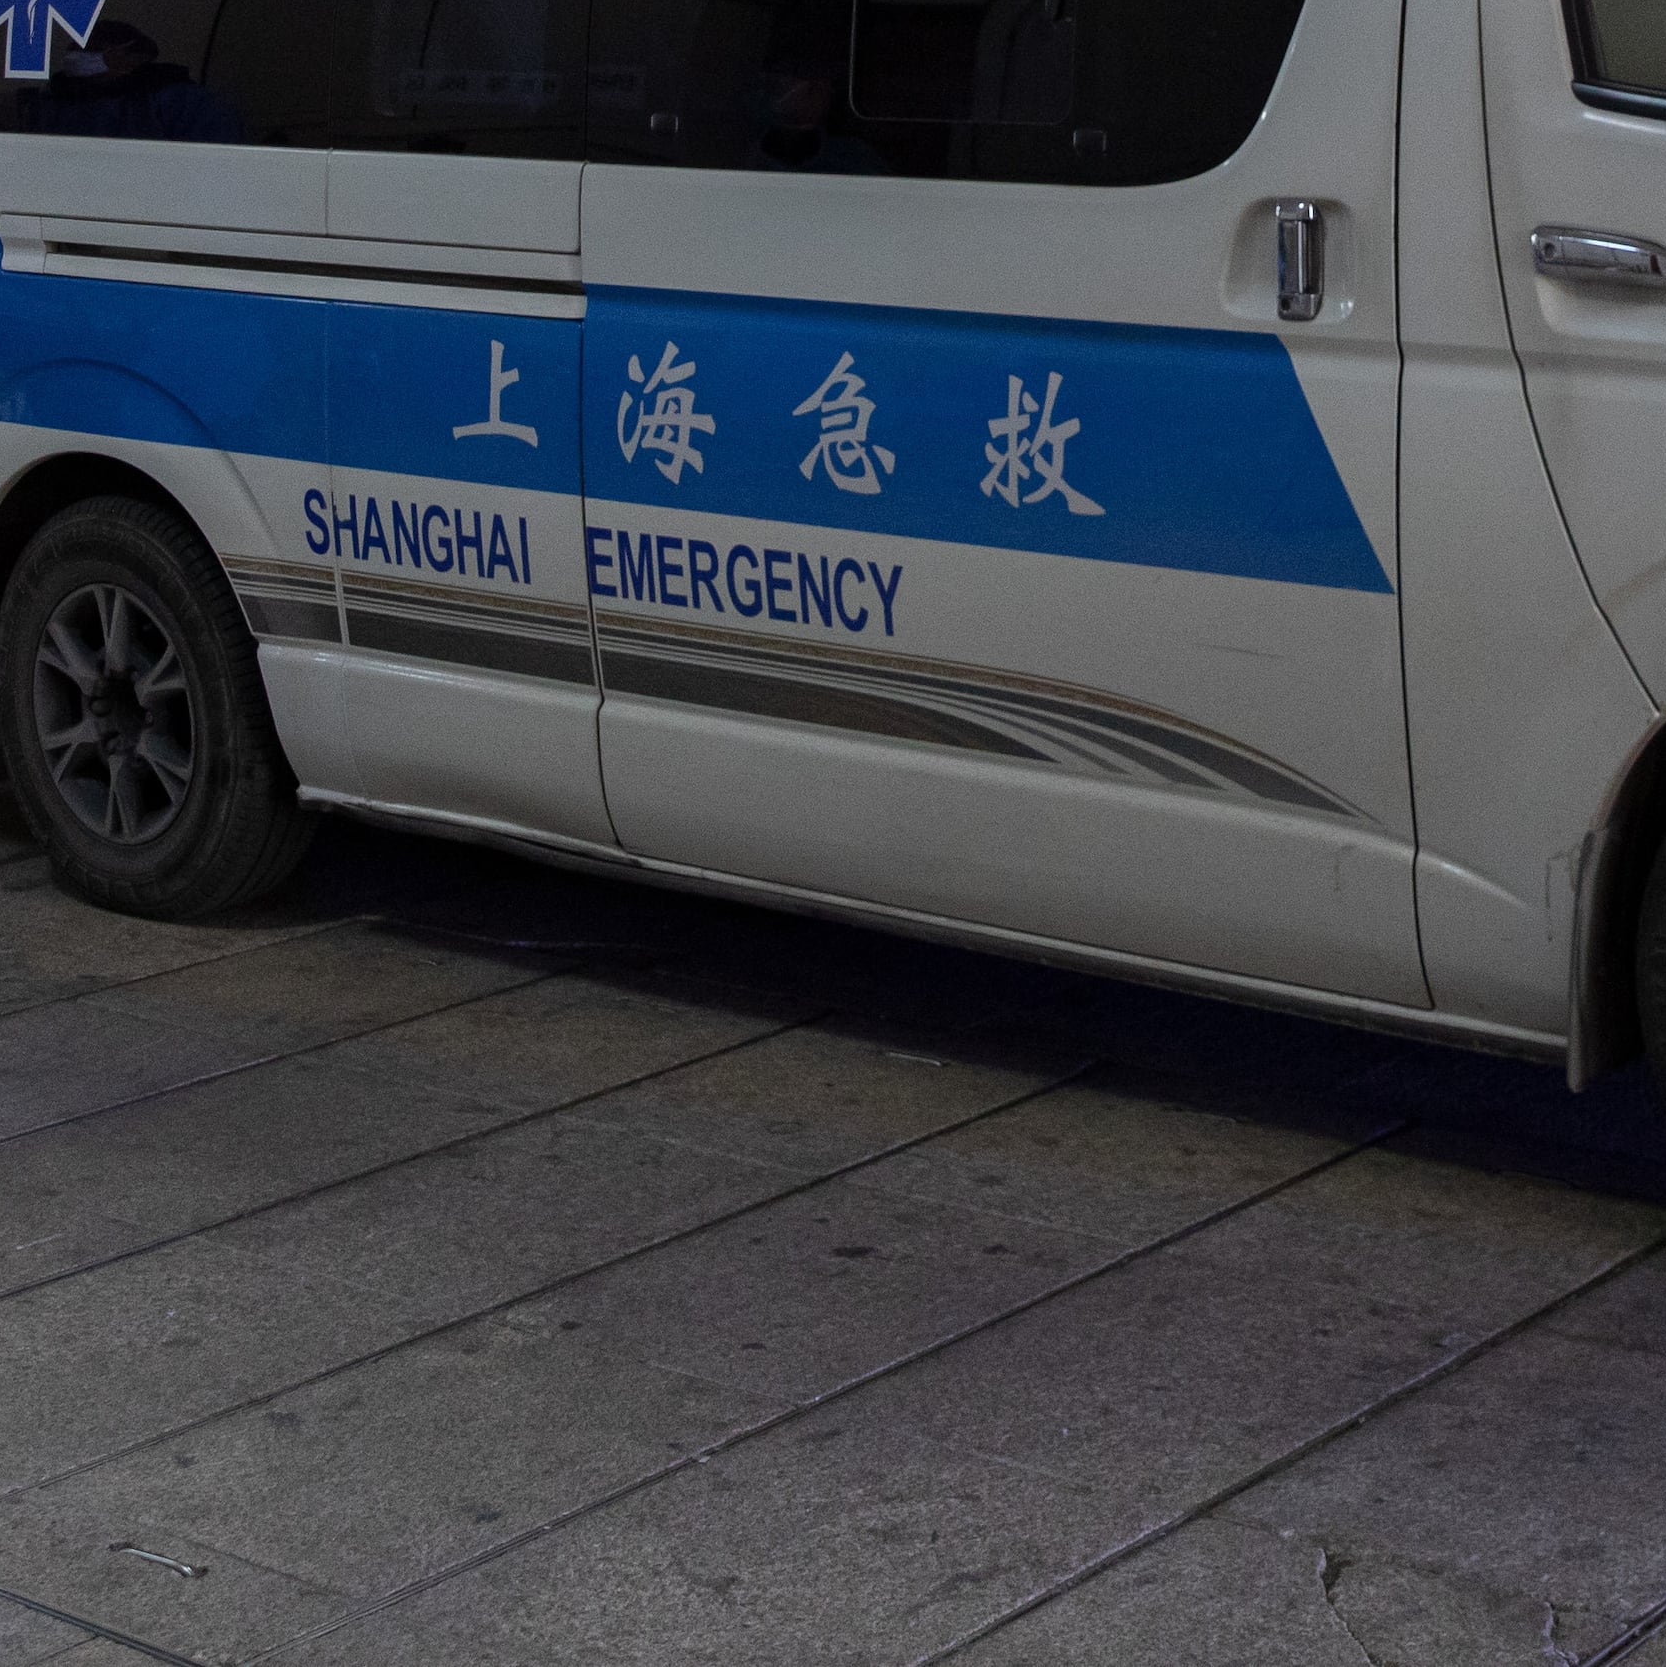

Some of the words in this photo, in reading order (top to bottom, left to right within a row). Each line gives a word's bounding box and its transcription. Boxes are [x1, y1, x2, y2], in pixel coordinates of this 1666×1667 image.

[451, 338, 1106, 516] 上海急救
[303, 487, 532, 586] SHANGHAI
[586, 525, 904, 637] EMERGENCY
